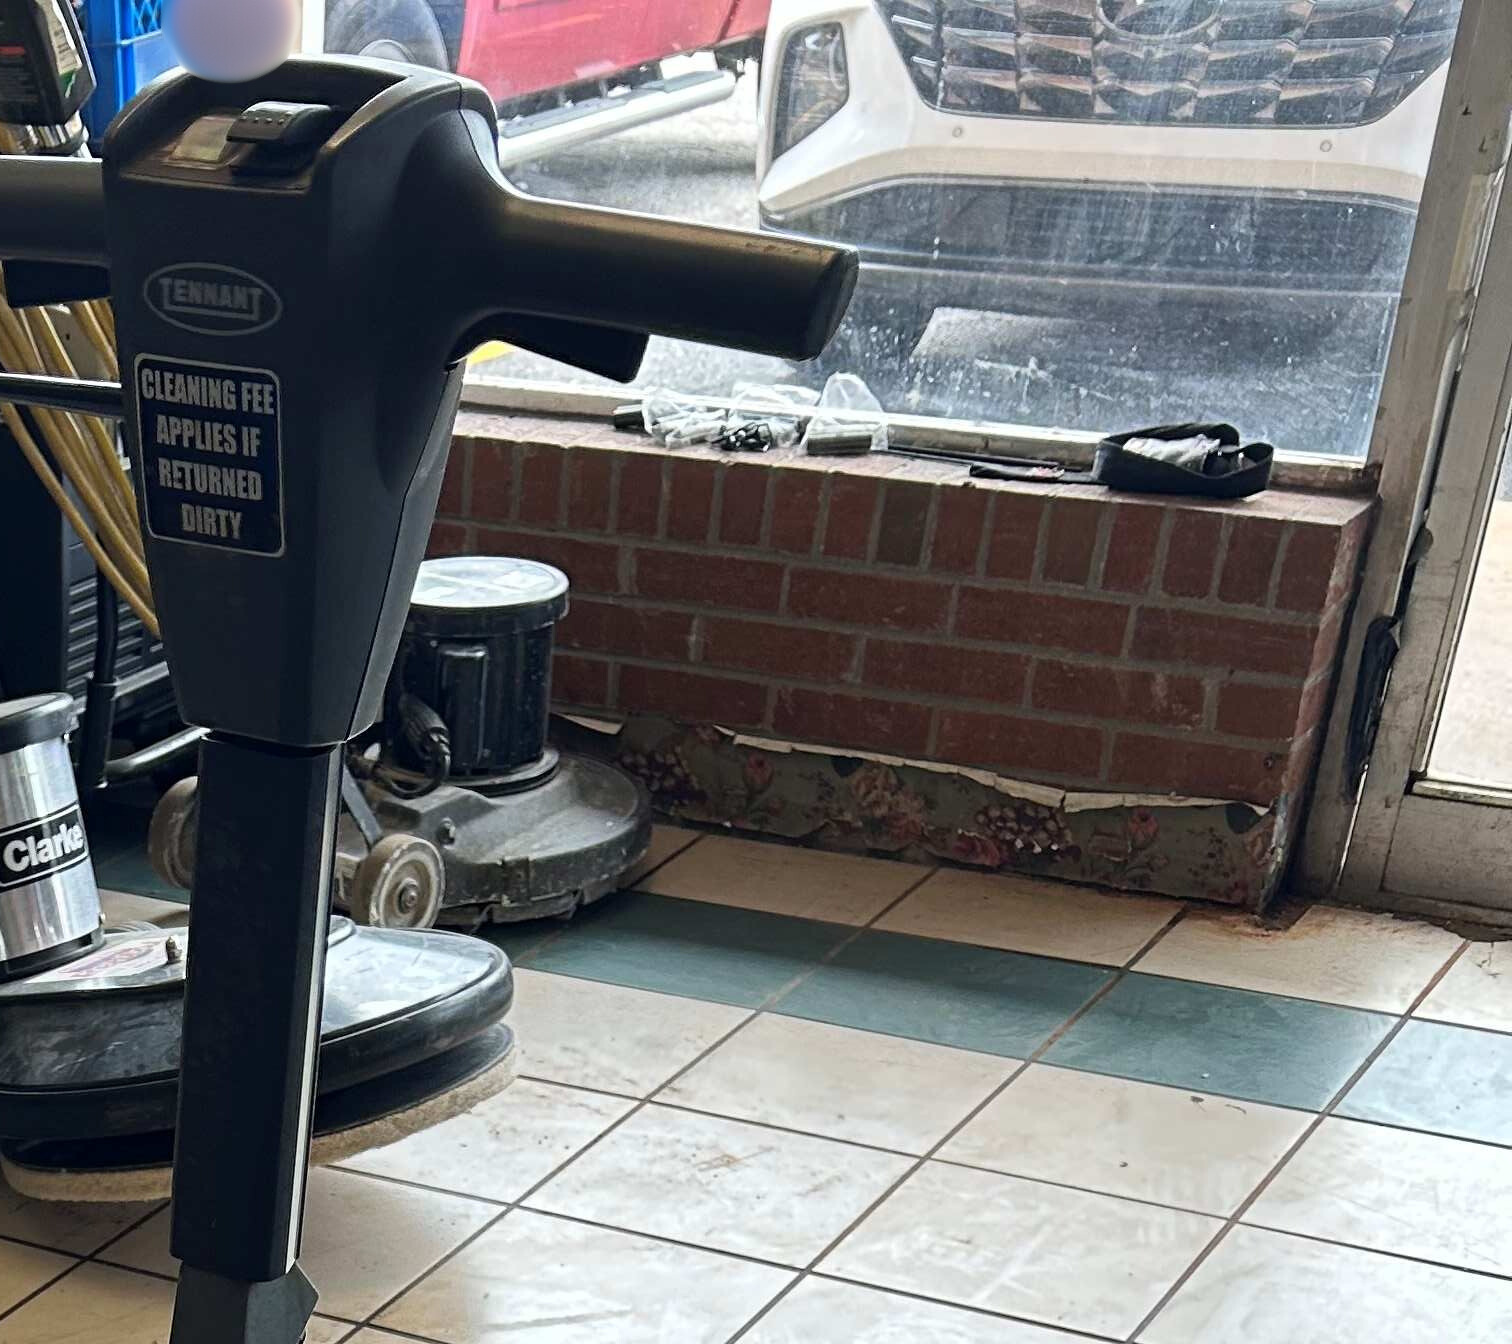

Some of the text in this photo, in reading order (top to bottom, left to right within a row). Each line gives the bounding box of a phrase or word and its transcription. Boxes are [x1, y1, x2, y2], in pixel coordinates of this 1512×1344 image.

[159, 277, 263, 320] TENNANT
[141, 368, 275, 415] CLEANING FEE
[156, 413, 261, 457] APPLIES IF
[158, 457, 263, 501] RETURNED
[181, 503, 243, 540] DIRTY
[3, 823, 85, 872] Clarke
